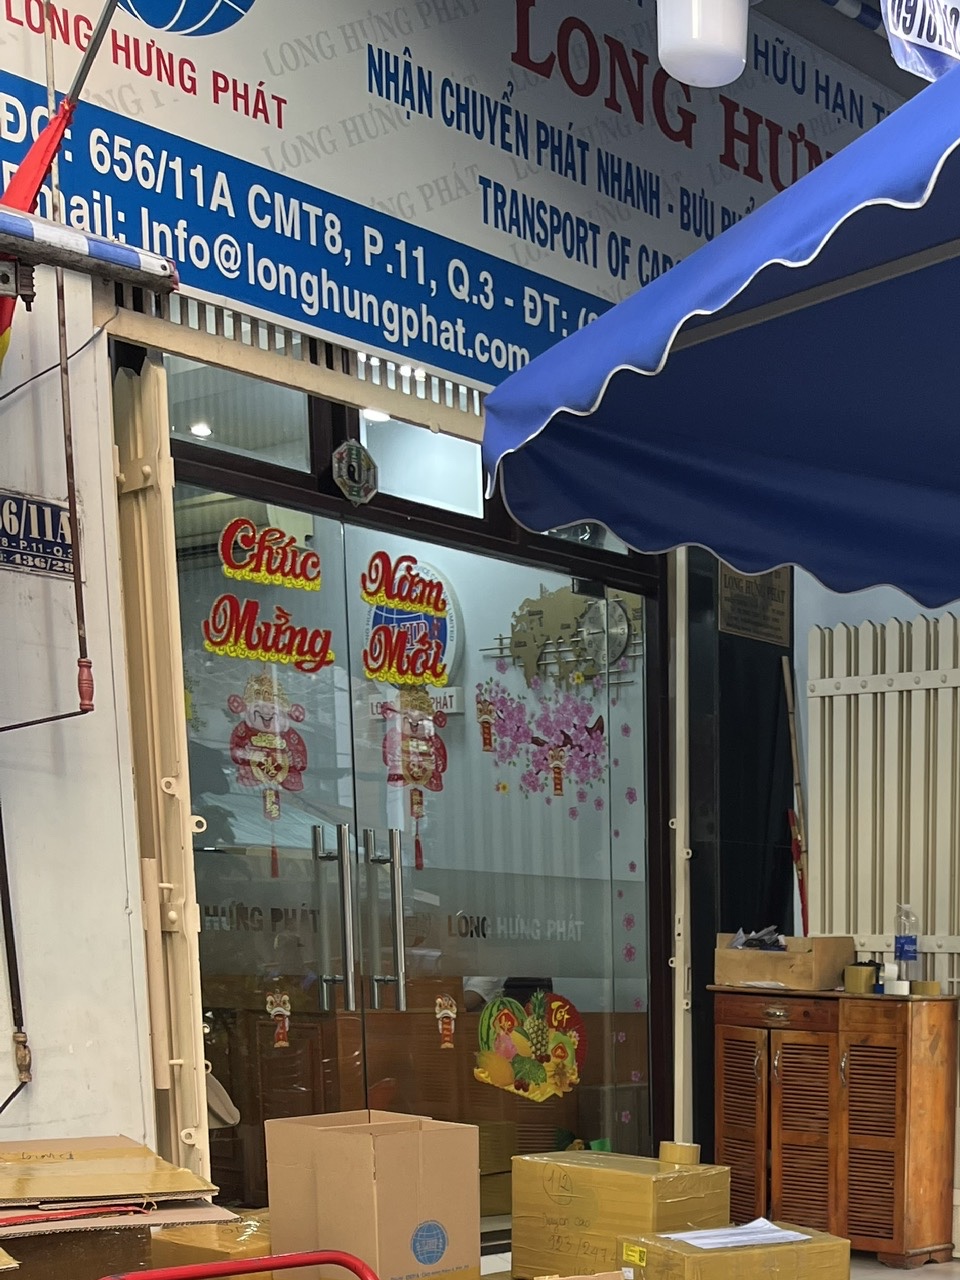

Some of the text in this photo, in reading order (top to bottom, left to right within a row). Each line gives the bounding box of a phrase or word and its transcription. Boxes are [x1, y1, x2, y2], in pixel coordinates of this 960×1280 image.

[111, 28, 197, 96] HƯNG
[211, 80, 288, 129] PHÁT
[511, 0, 697, 149] LONG
[753, 33, 806, 95] HỮU
[815, 68, 864, 129] HẠN
[367, 43, 434, 120] NHẬN
[440, 81, 529, 161] CHUYỂN
[536, 121, 590, 186] PHÁT
[597, 148, 661, 219] NHANH
[680, 186, 715, 242] BƯU
[89, 128, 235, 218] 656/11A
[248, 184, 352, 267] CMT8,
[363, 225, 437, 298] P.11,
[448, 258, 493, 310] Q.3
[523, 286, 568, 338] ĐT:
[478, 175, 600, 269] TRANSPORT
[607, 231, 631, 280] OF
[141, 206, 530, 374] Info@longhungphat.com
[0, 499, 72, 544] 6/11A
[219, 517, 321, 582] Chúc
[362, 551, 447, 612] Năm
[203, 593, 334, 673] Mừng
[363, 625, 447, 678] Mới
